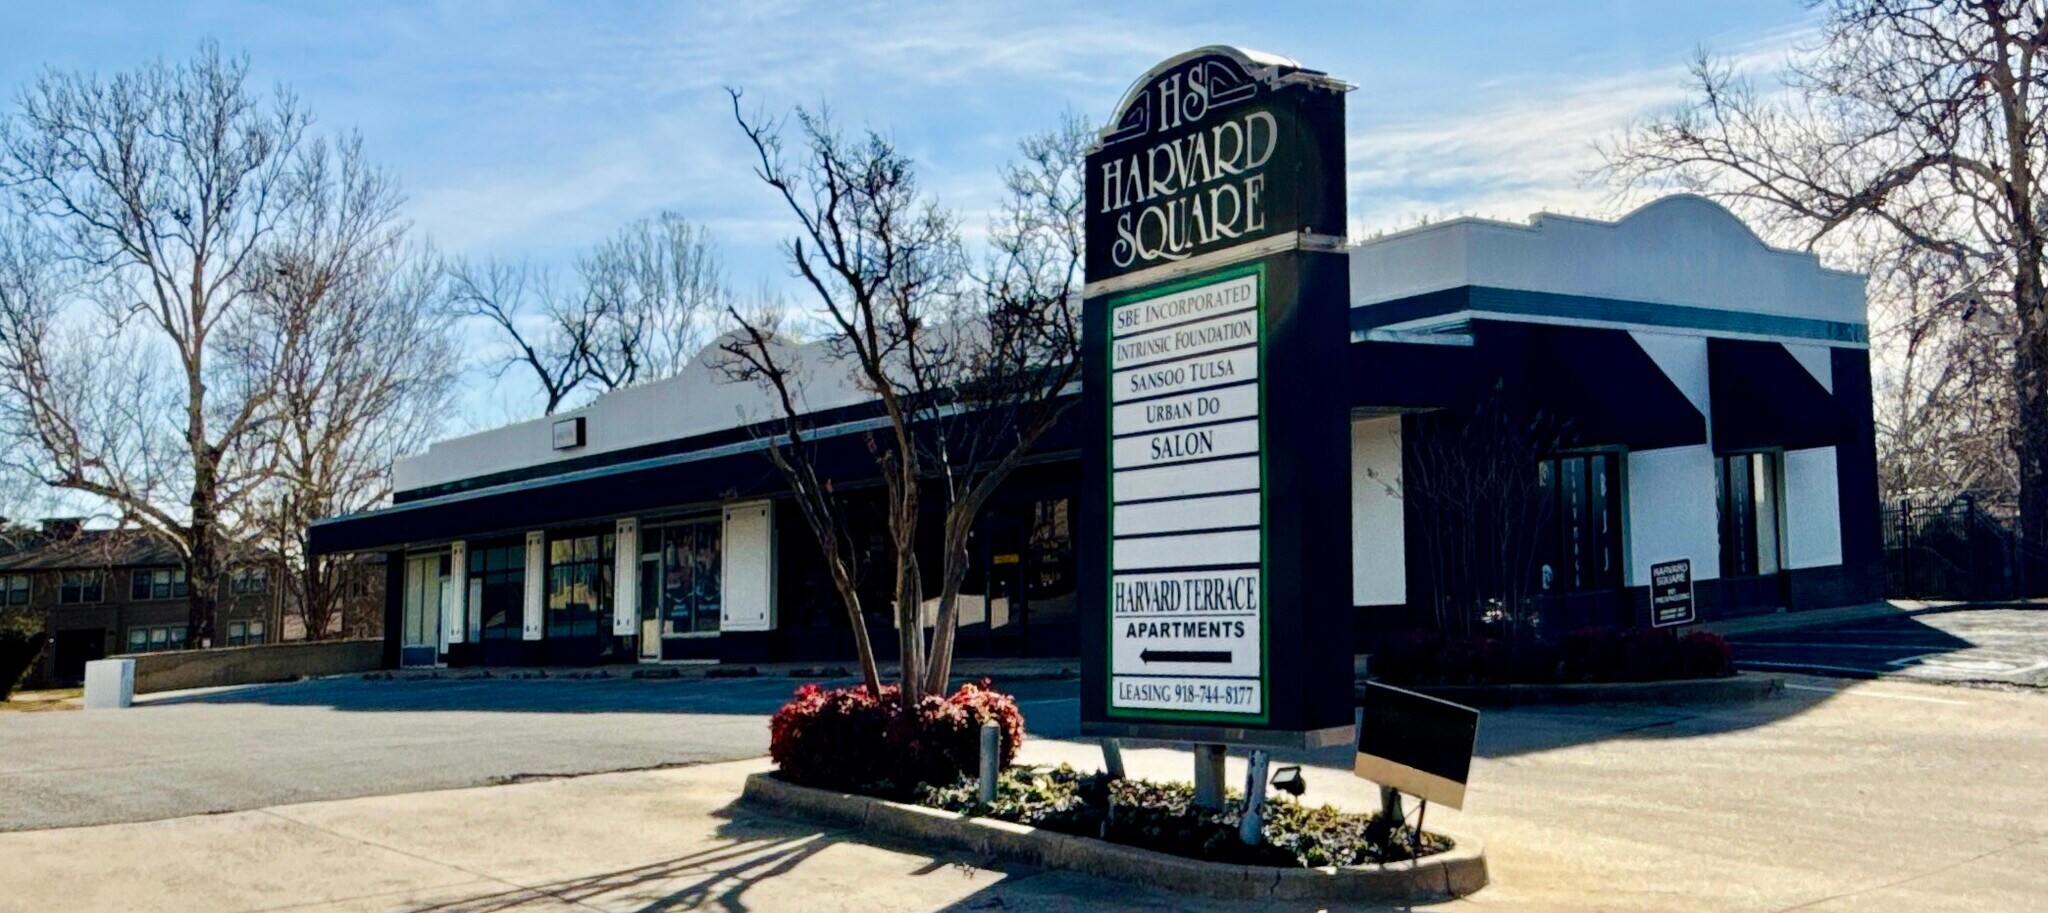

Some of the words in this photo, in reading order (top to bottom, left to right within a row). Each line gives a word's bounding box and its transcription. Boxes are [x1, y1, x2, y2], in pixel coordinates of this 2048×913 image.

[1158, 63, 1208, 132] HS
[1101, 111, 1278, 213] HARVARD
[1112, 172, 1265, 267] SQUARE
[1117, 308, 1141, 329] SBE
[1146, 284, 1251, 323] INCORPORATED
[1117, 336, 1171, 361] INTRINSIC
[1175, 319, 1252, 350] FOUNDATION
[1131, 368, 1185, 393] SANSOO
[1190, 359, 1234, 382] TULSA
[1146, 402, 1192, 424] URBAN
[1198, 397, 1220, 416] DO
[1151, 429, 1214, 460] SALON
[1115, 579, 1181, 613] HARVARD
[1183, 577, 1256, 611] TERRACE
[1126, 621, 1245, 639] APARTMENTS
[1119, 682, 1171, 702] LEASING
[1175, 684, 1253, 705] 918-744-8177
